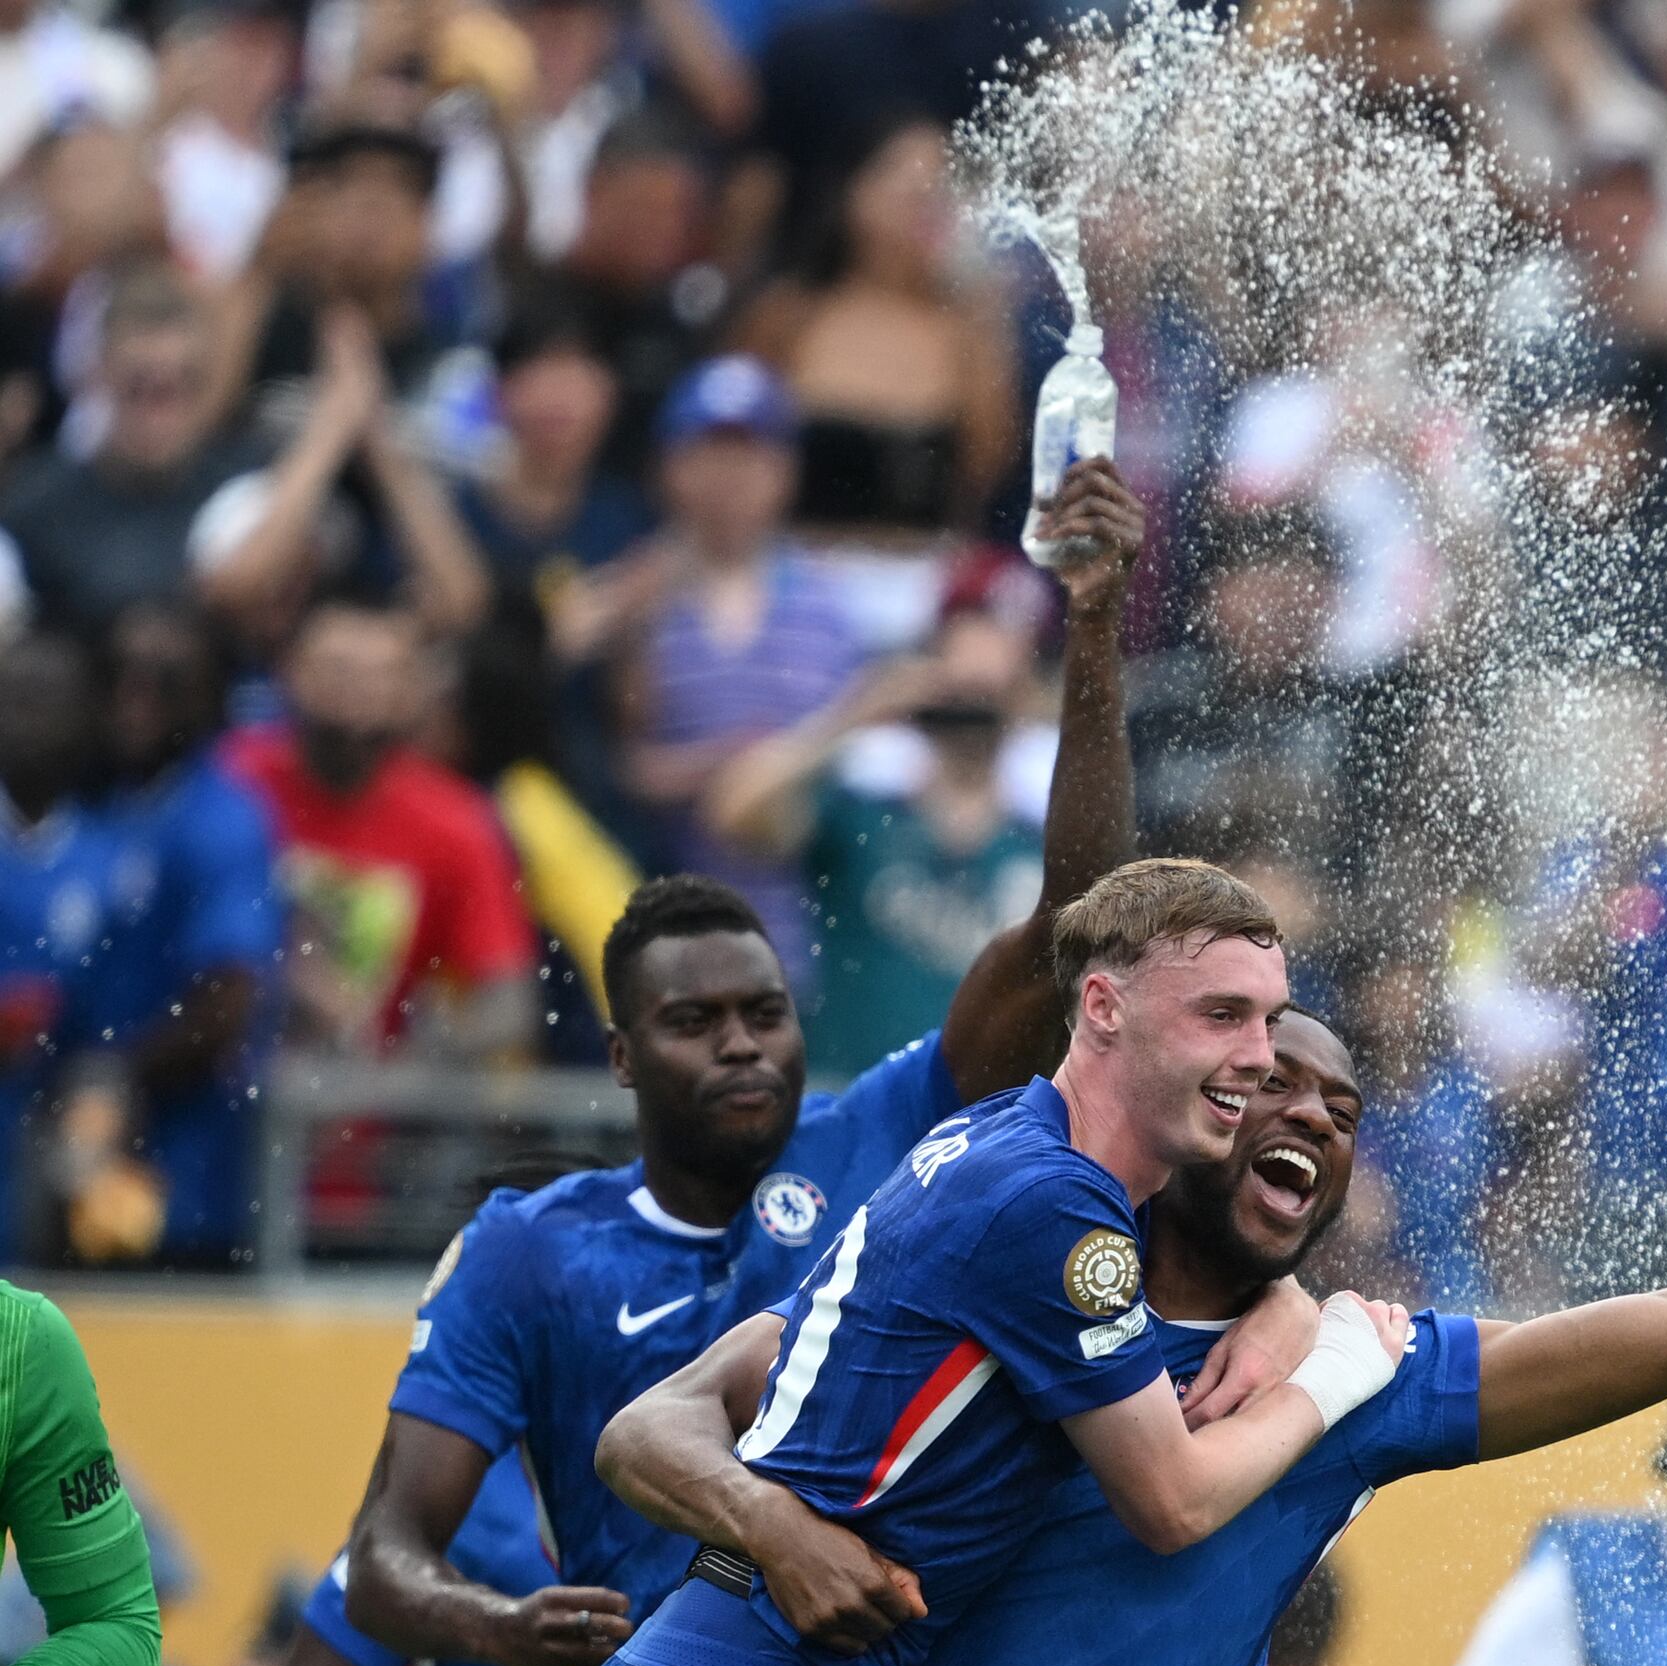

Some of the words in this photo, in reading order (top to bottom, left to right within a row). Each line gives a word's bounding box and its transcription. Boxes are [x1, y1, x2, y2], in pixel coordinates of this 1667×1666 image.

[1106, 1235, 1127, 1249] CUP
[1073, 1238, 1105, 1271] WORLD
[1073, 1275, 1091, 1302] CLUB
[1094, 1293, 1124, 1311] FIFA
[1088, 1322, 1124, 1341] FOOTBALL
[59, 1455, 107, 1499] LIVE
